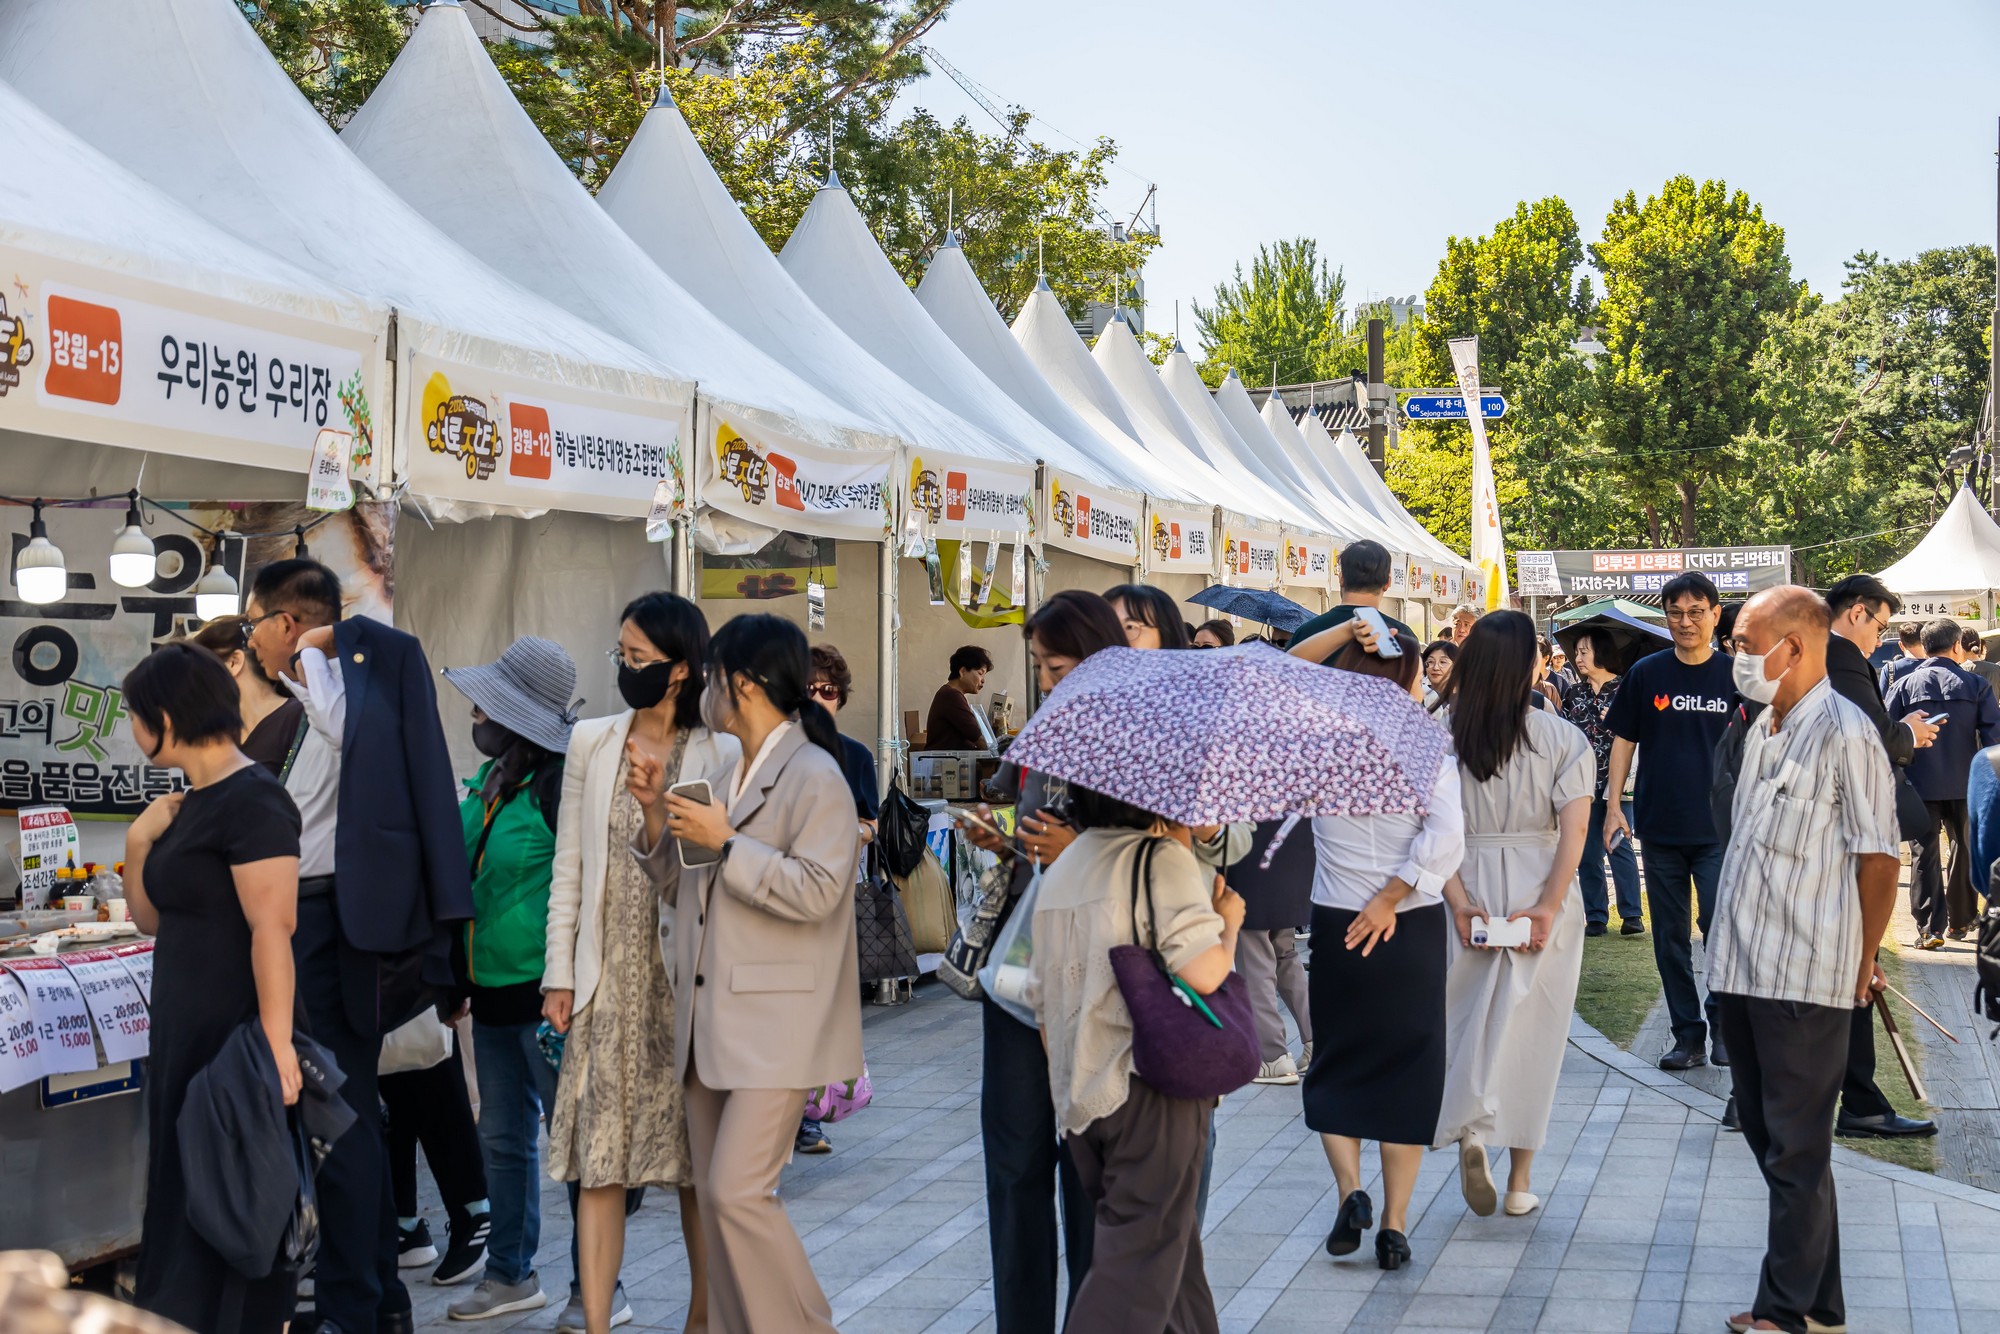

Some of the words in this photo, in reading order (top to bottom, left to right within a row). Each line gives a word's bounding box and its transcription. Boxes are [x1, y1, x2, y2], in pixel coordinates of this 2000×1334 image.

[53, 330, 119, 374] 강원-13
[158, 335, 256, 413] 우리농원
[266, 358, 331, 426] 우리장
[1410, 404, 1420, 412] 96
[1435, 399, 1466, 409] 세종대
[1488, 403, 1501, 411] 100
[512, 427, 551, 457] 강원-12
[1671, 694, 1728, 714] GitLab
[0, 759, 32, 801] 을
[41, 761, 104, 803] 품은
[110, 763, 192, 804] 전통
[24, 869, 58, 890] 조선간장
[113, 1001, 145, 1020] 20,000
[8, 1020, 34, 1042] 20,00
[38, 1022, 54, 1040] 1근
[57, 1014, 88, 1031] 20,000
[119, 1017, 151, 1036] 15,000
[13, 1038, 39, 1059] 15,00
[60, 1031, 91, 1049] 15,000
